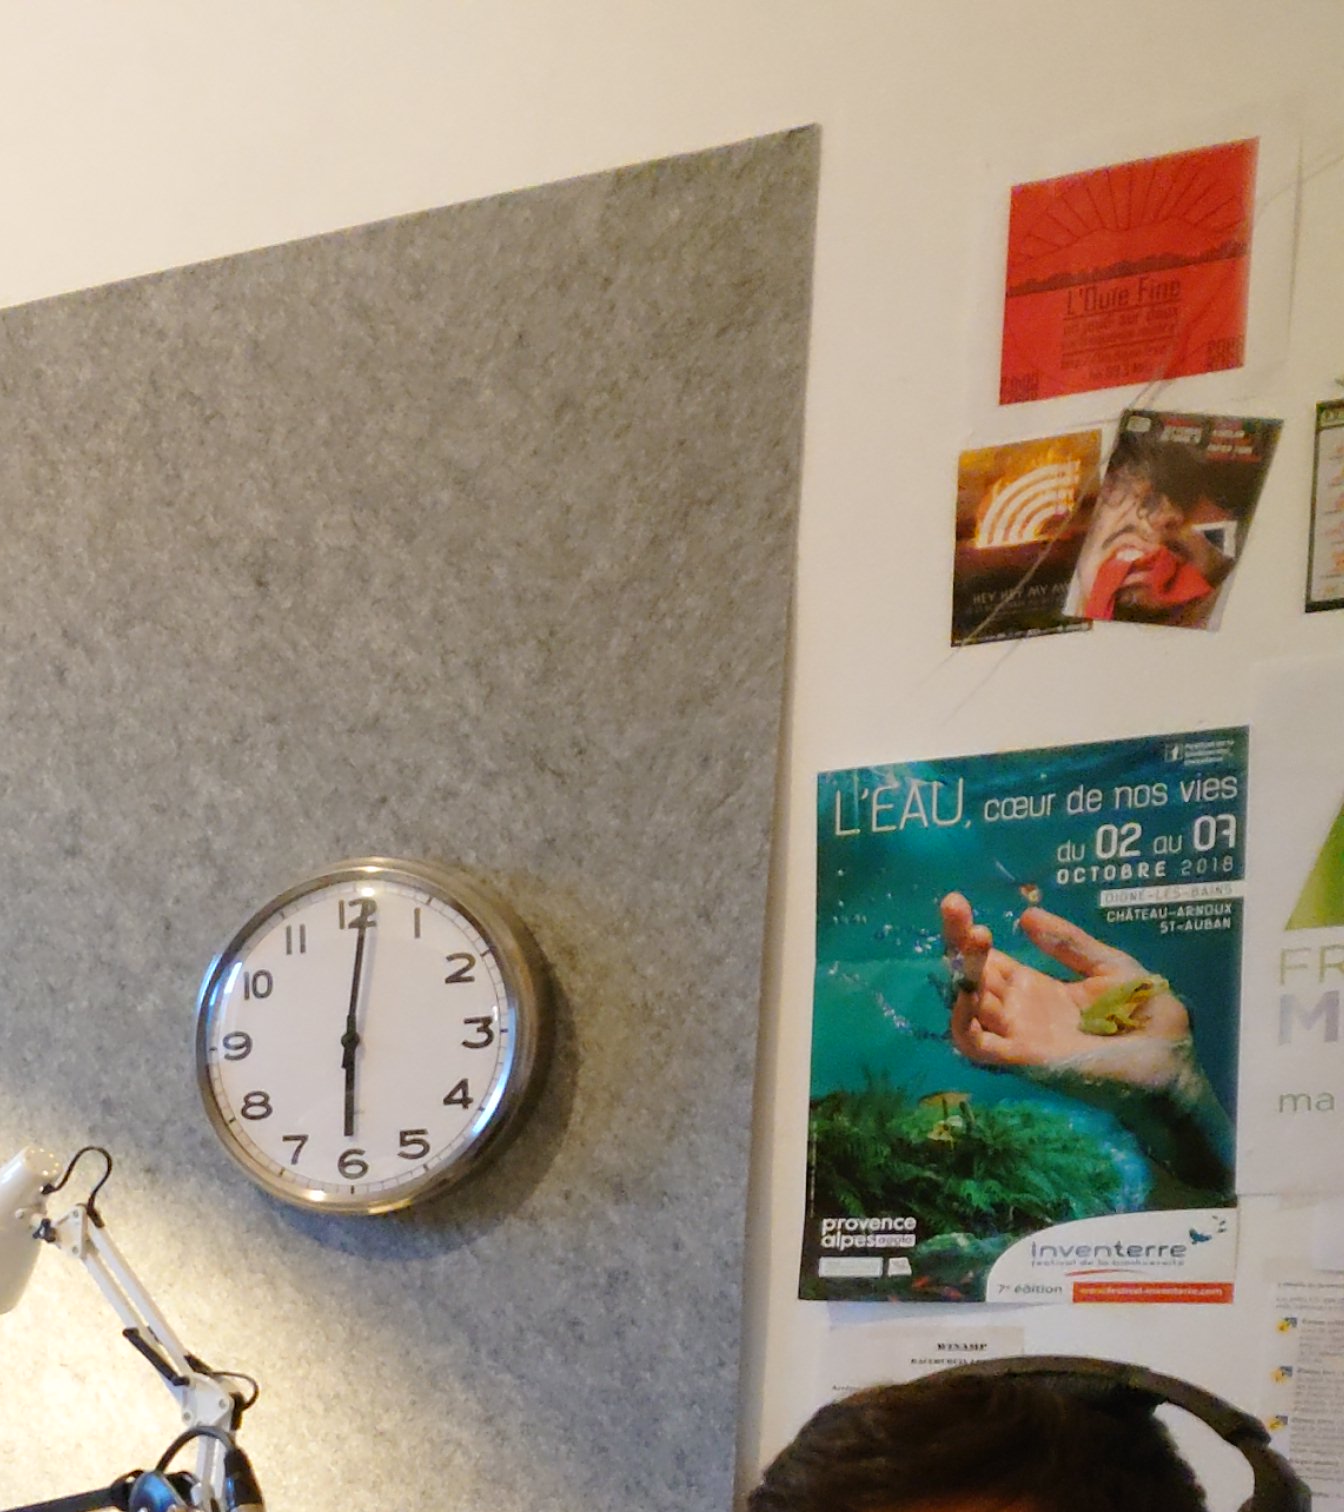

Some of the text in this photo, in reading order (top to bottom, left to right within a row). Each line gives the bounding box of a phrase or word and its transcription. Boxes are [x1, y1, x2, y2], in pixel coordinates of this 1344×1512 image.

[835, 772, 1238, 836] L'EAU, cœur de nos vies
[1057, 813, 1237, 862] du 02 au 07
[1057, 856, 1234, 885] OCTOBRE 2018
[339, 898, 378, 930] 12
[414, 907, 421, 939] 1
[1106, 902, 1232, 923] CHÂTEAU-ARNOUX
[1160, 917, 1231, 934] ST-AUBAN
[286, 924, 306, 955] 11
[445, 952, 476, 985] 2
[244, 969, 273, 1000] 10
[222, 1031, 253, 1061] 9
[461, 1015, 494, 1049] 3
[241, 1090, 273, 1120] 8
[442, 1078, 474, 1109] 4
[1279, 1091, 1335, 1113] ma
[282, 1133, 309, 1165] 7
[397, 1129, 431, 1160] 5
[337, 1148, 369, 1180] 6
[821, 1216, 917, 1236] provence
[821, 1231, 875, 1252] alpes
[1031, 1240, 1187, 1259] Inventerre
[1014, 1283, 1063, 1294] édition
